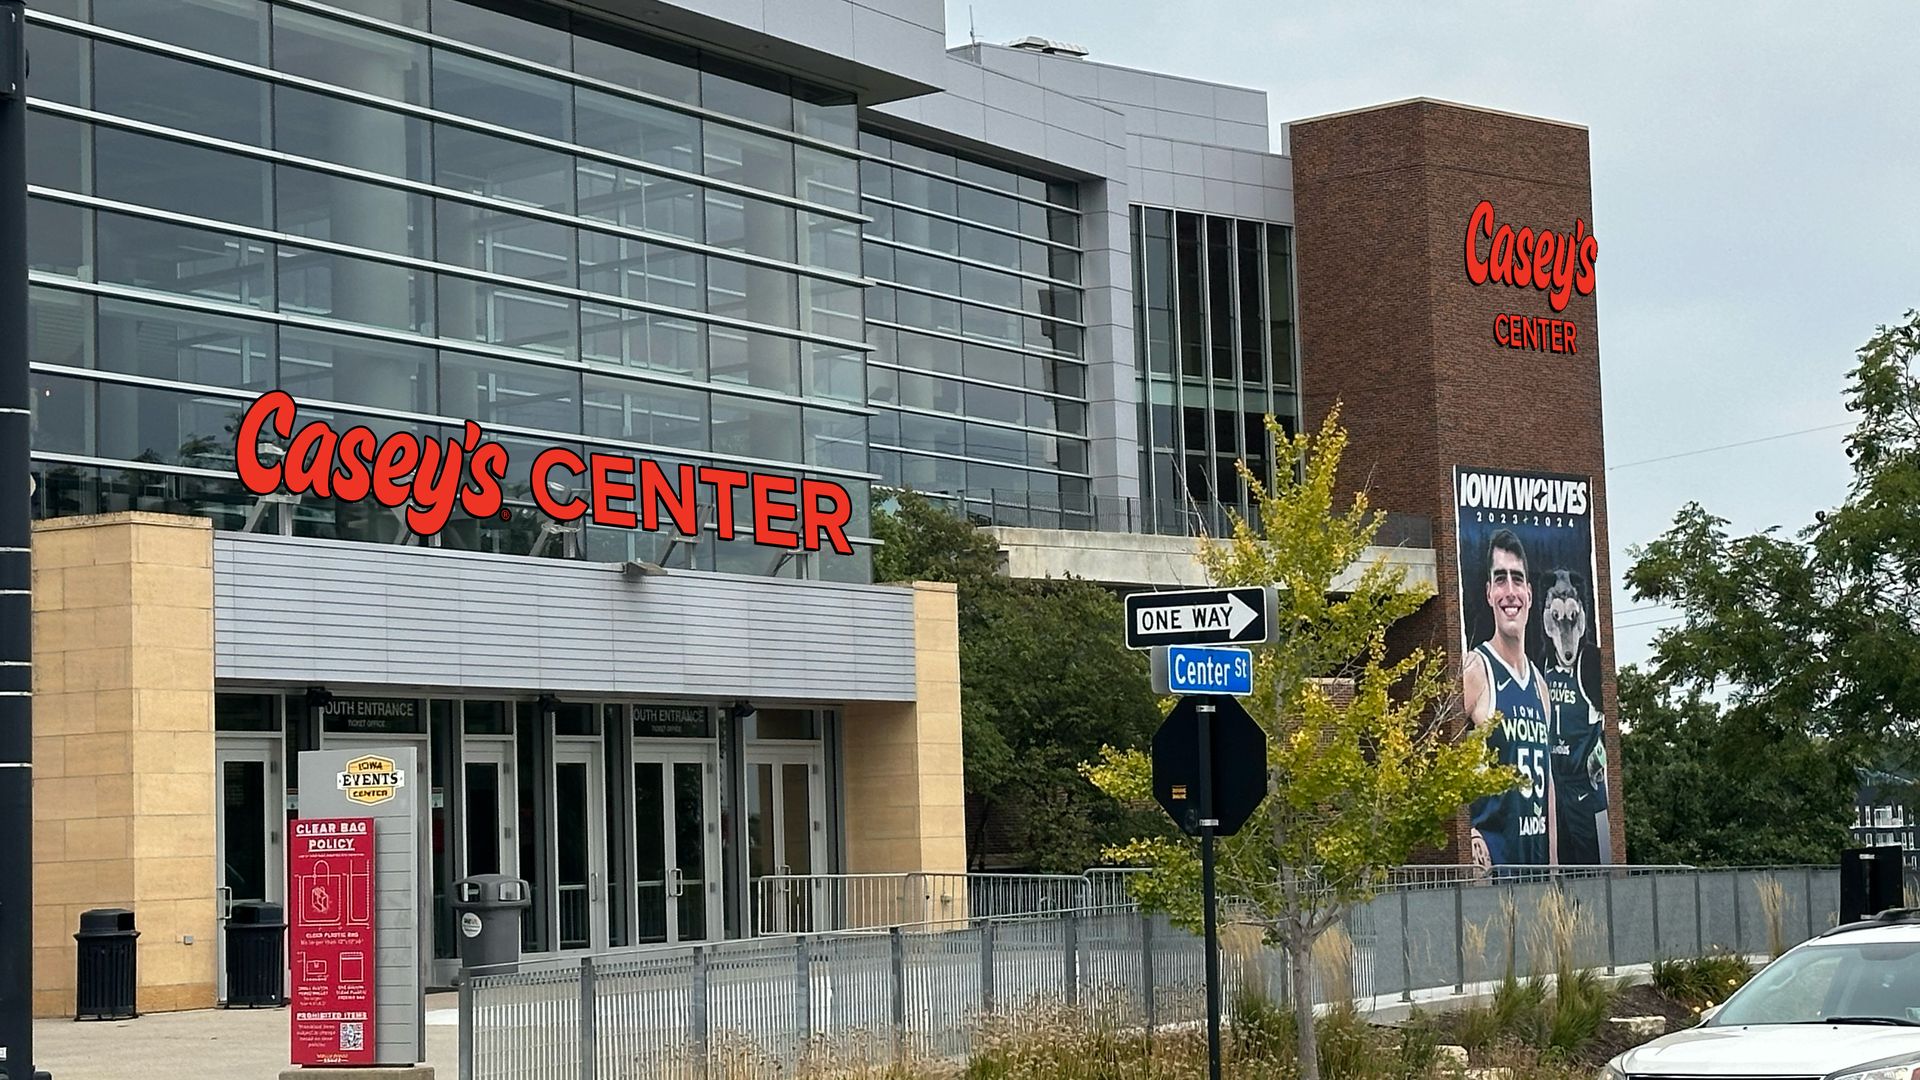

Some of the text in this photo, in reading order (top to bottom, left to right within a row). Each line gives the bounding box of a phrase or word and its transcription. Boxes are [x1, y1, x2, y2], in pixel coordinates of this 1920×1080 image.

[1465, 200, 1598, 312] Casey's
[1494, 313, 1577, 354] CENTER
[235, 389, 854, 556] Casey's CENTER
[1460, 473, 1587, 515] IOWA WOLVES
[1142, 606, 1233, 631] ONE WAY
[1175, 654, 1247, 686] Center St
[1549, 688, 1576, 705] OLVES
[325, 701, 414, 716] OUTH ENTRANCE
[633, 708, 704, 722] OUTH ENTRANCE
[1512, 705, 1541, 719] IOWA
[358, 761, 383, 771] IOWA
[1517, 747, 1545, 799] 55
[342, 772, 398, 787] EVENTS
[352, 790, 388, 798] CENTER
[296, 822, 366, 834] CLEAR BAG
[308, 838, 355, 850] POLICY
